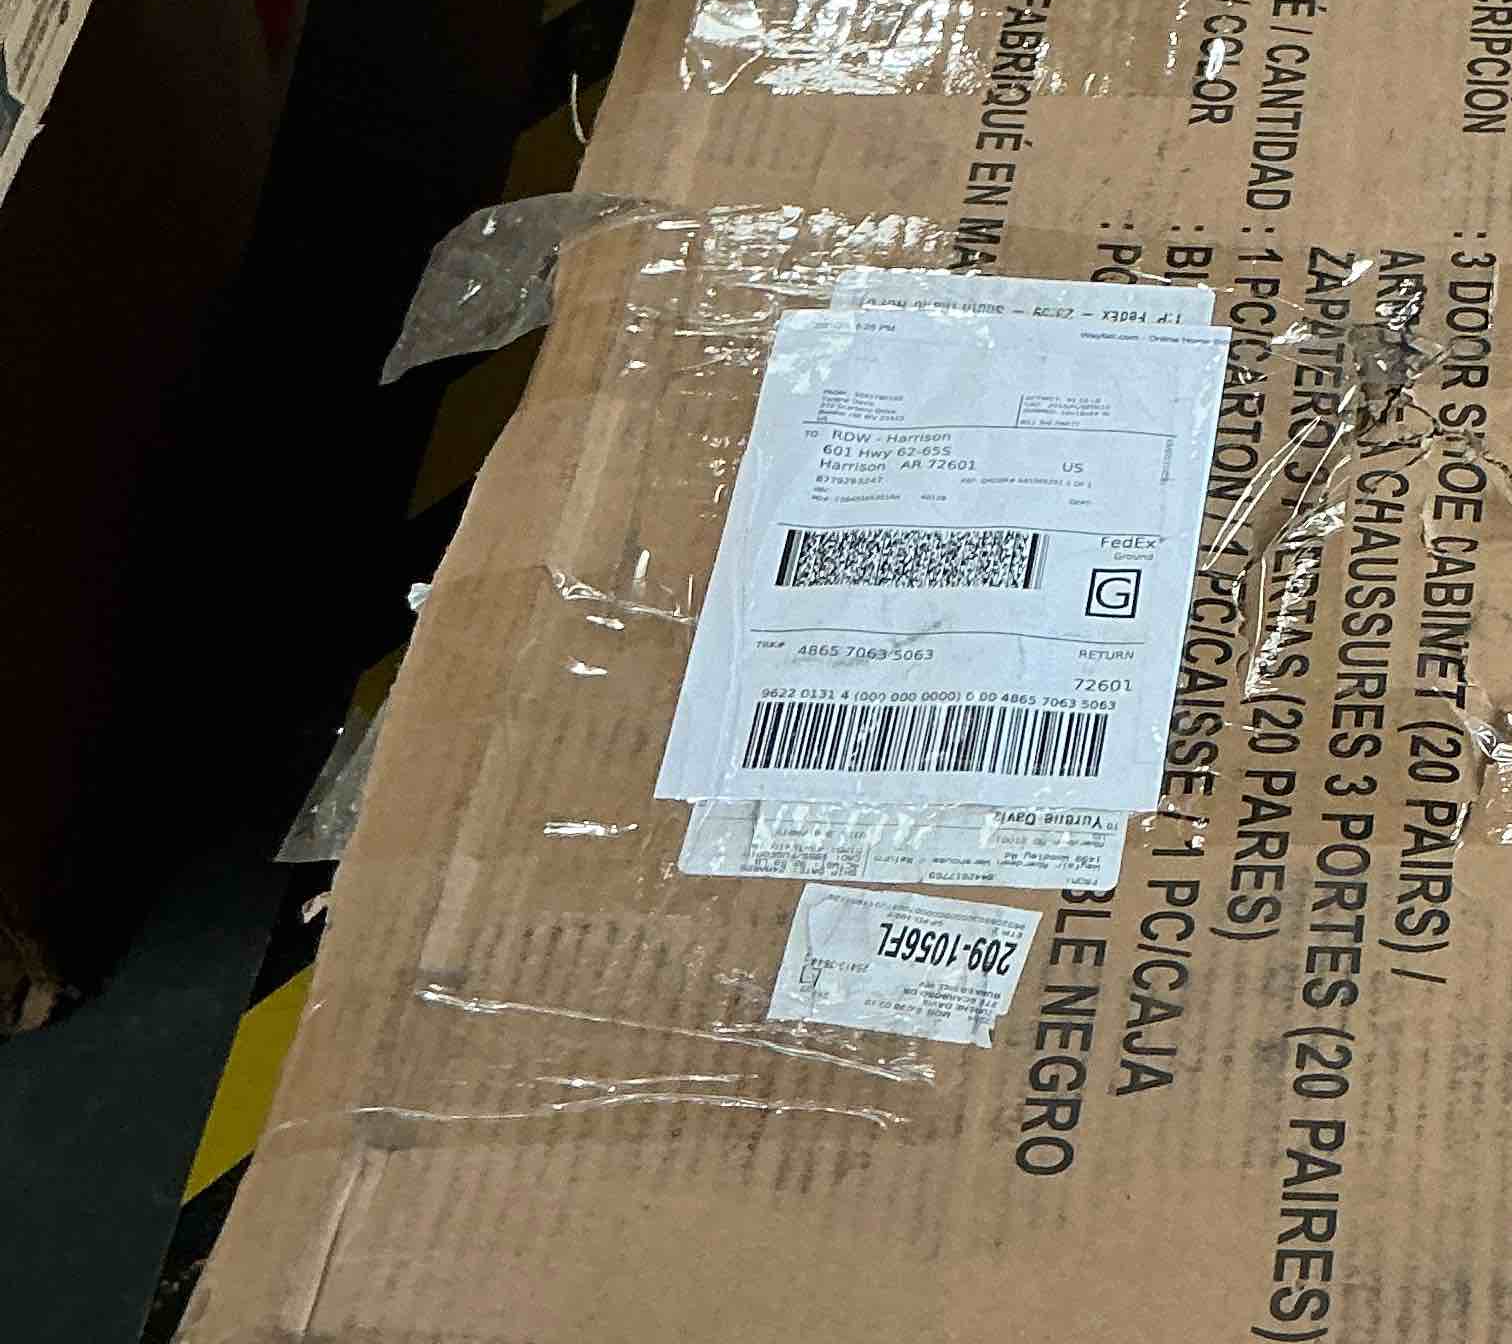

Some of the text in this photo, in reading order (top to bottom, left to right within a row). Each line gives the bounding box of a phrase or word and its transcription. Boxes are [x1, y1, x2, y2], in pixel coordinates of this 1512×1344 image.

[1246, 44, 1313, 211] CANTIDAD
[962, 162, 1017, 205] EN
[1288, 247, 1355, 448] ZAPATERO
[1441, 281, 1494, 390] DOOR
[823, 445, 851, 458] 601
[858, 447, 892, 460] Hwy
[886, 430, 952, 444] Harrison
[900, 459, 923, 471] AR
[928, 459, 976, 471] 72601
[1063, 462, 1083, 473] US
[1101, 537, 1157, 550] FedEx
[1259, 498, 1323, 678] PERTAS
[1328, 469, 1409, 759] CHAUSSURES
[1414, 535, 1479, 709] CABINET
[797, 645, 841, 659] 4865
[845, 647, 888, 661] 7063
[1073, 679, 1132, 692] 72601
[1079, 650, 1135, 661] RETURN
[761, 688, 797, 700] 9622
[1000, 693, 1037, 705] 4865
[1042, 697, 1077, 708] 7063
[1080, 699, 1116, 710] 5063
[1240, 694, 1306, 754] (20
[1323, 774, 1378, 797] 3
[1398, 721, 1464, 784] (20
[1209, 769, 1296, 941] PARES)
[1378, 799, 1461, 952] PAIRS)
[1302, 813, 1375, 1010] PORTES
[877, 922, 1017, 976] 209-1056FL
[1116, 880, 1200, 1096] PC/CAJA
[1016, 984, 1101, 1176] NEGRO
[1282, 1027, 1355, 1100] (20
[1251, 1119, 1347, 1343] PAIRES)
